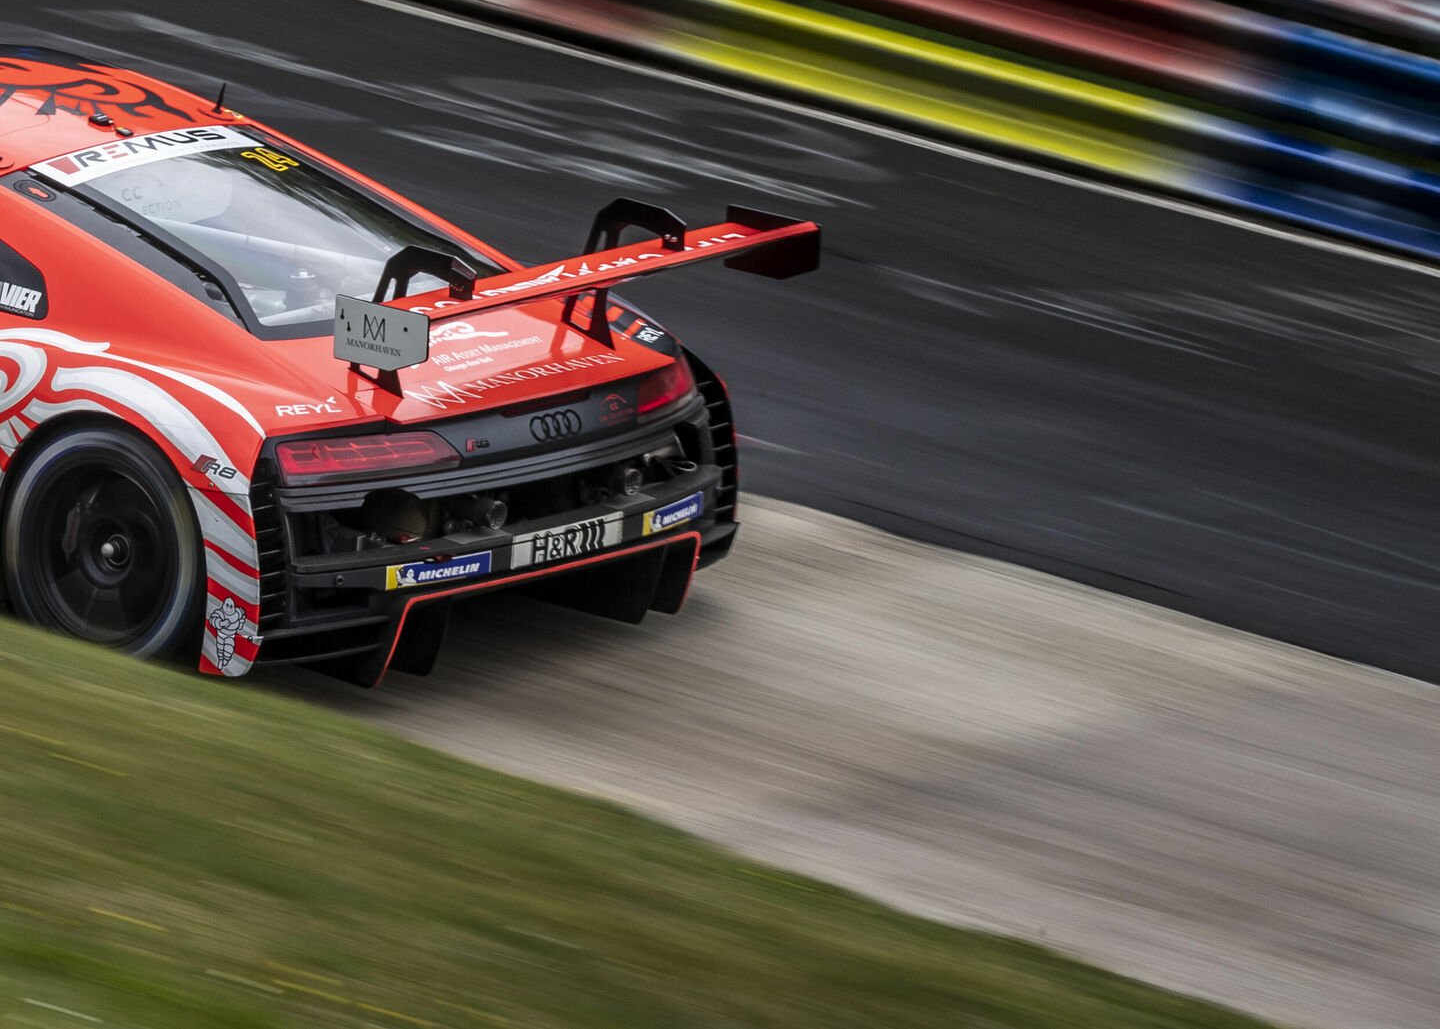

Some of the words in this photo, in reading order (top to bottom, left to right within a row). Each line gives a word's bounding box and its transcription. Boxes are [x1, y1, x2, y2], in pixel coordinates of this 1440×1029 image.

[73, 129, 227, 168] REMUS
[345, 337, 402, 357] MANORHAVEN
[463, 352, 628, 392] MANORHAVEN
[275, 402, 342, 417] REYL
[201, 461, 238, 480] R8
[662, 503, 699, 526] MICHELIN
[418, 562, 481, 581] MICHELIN
